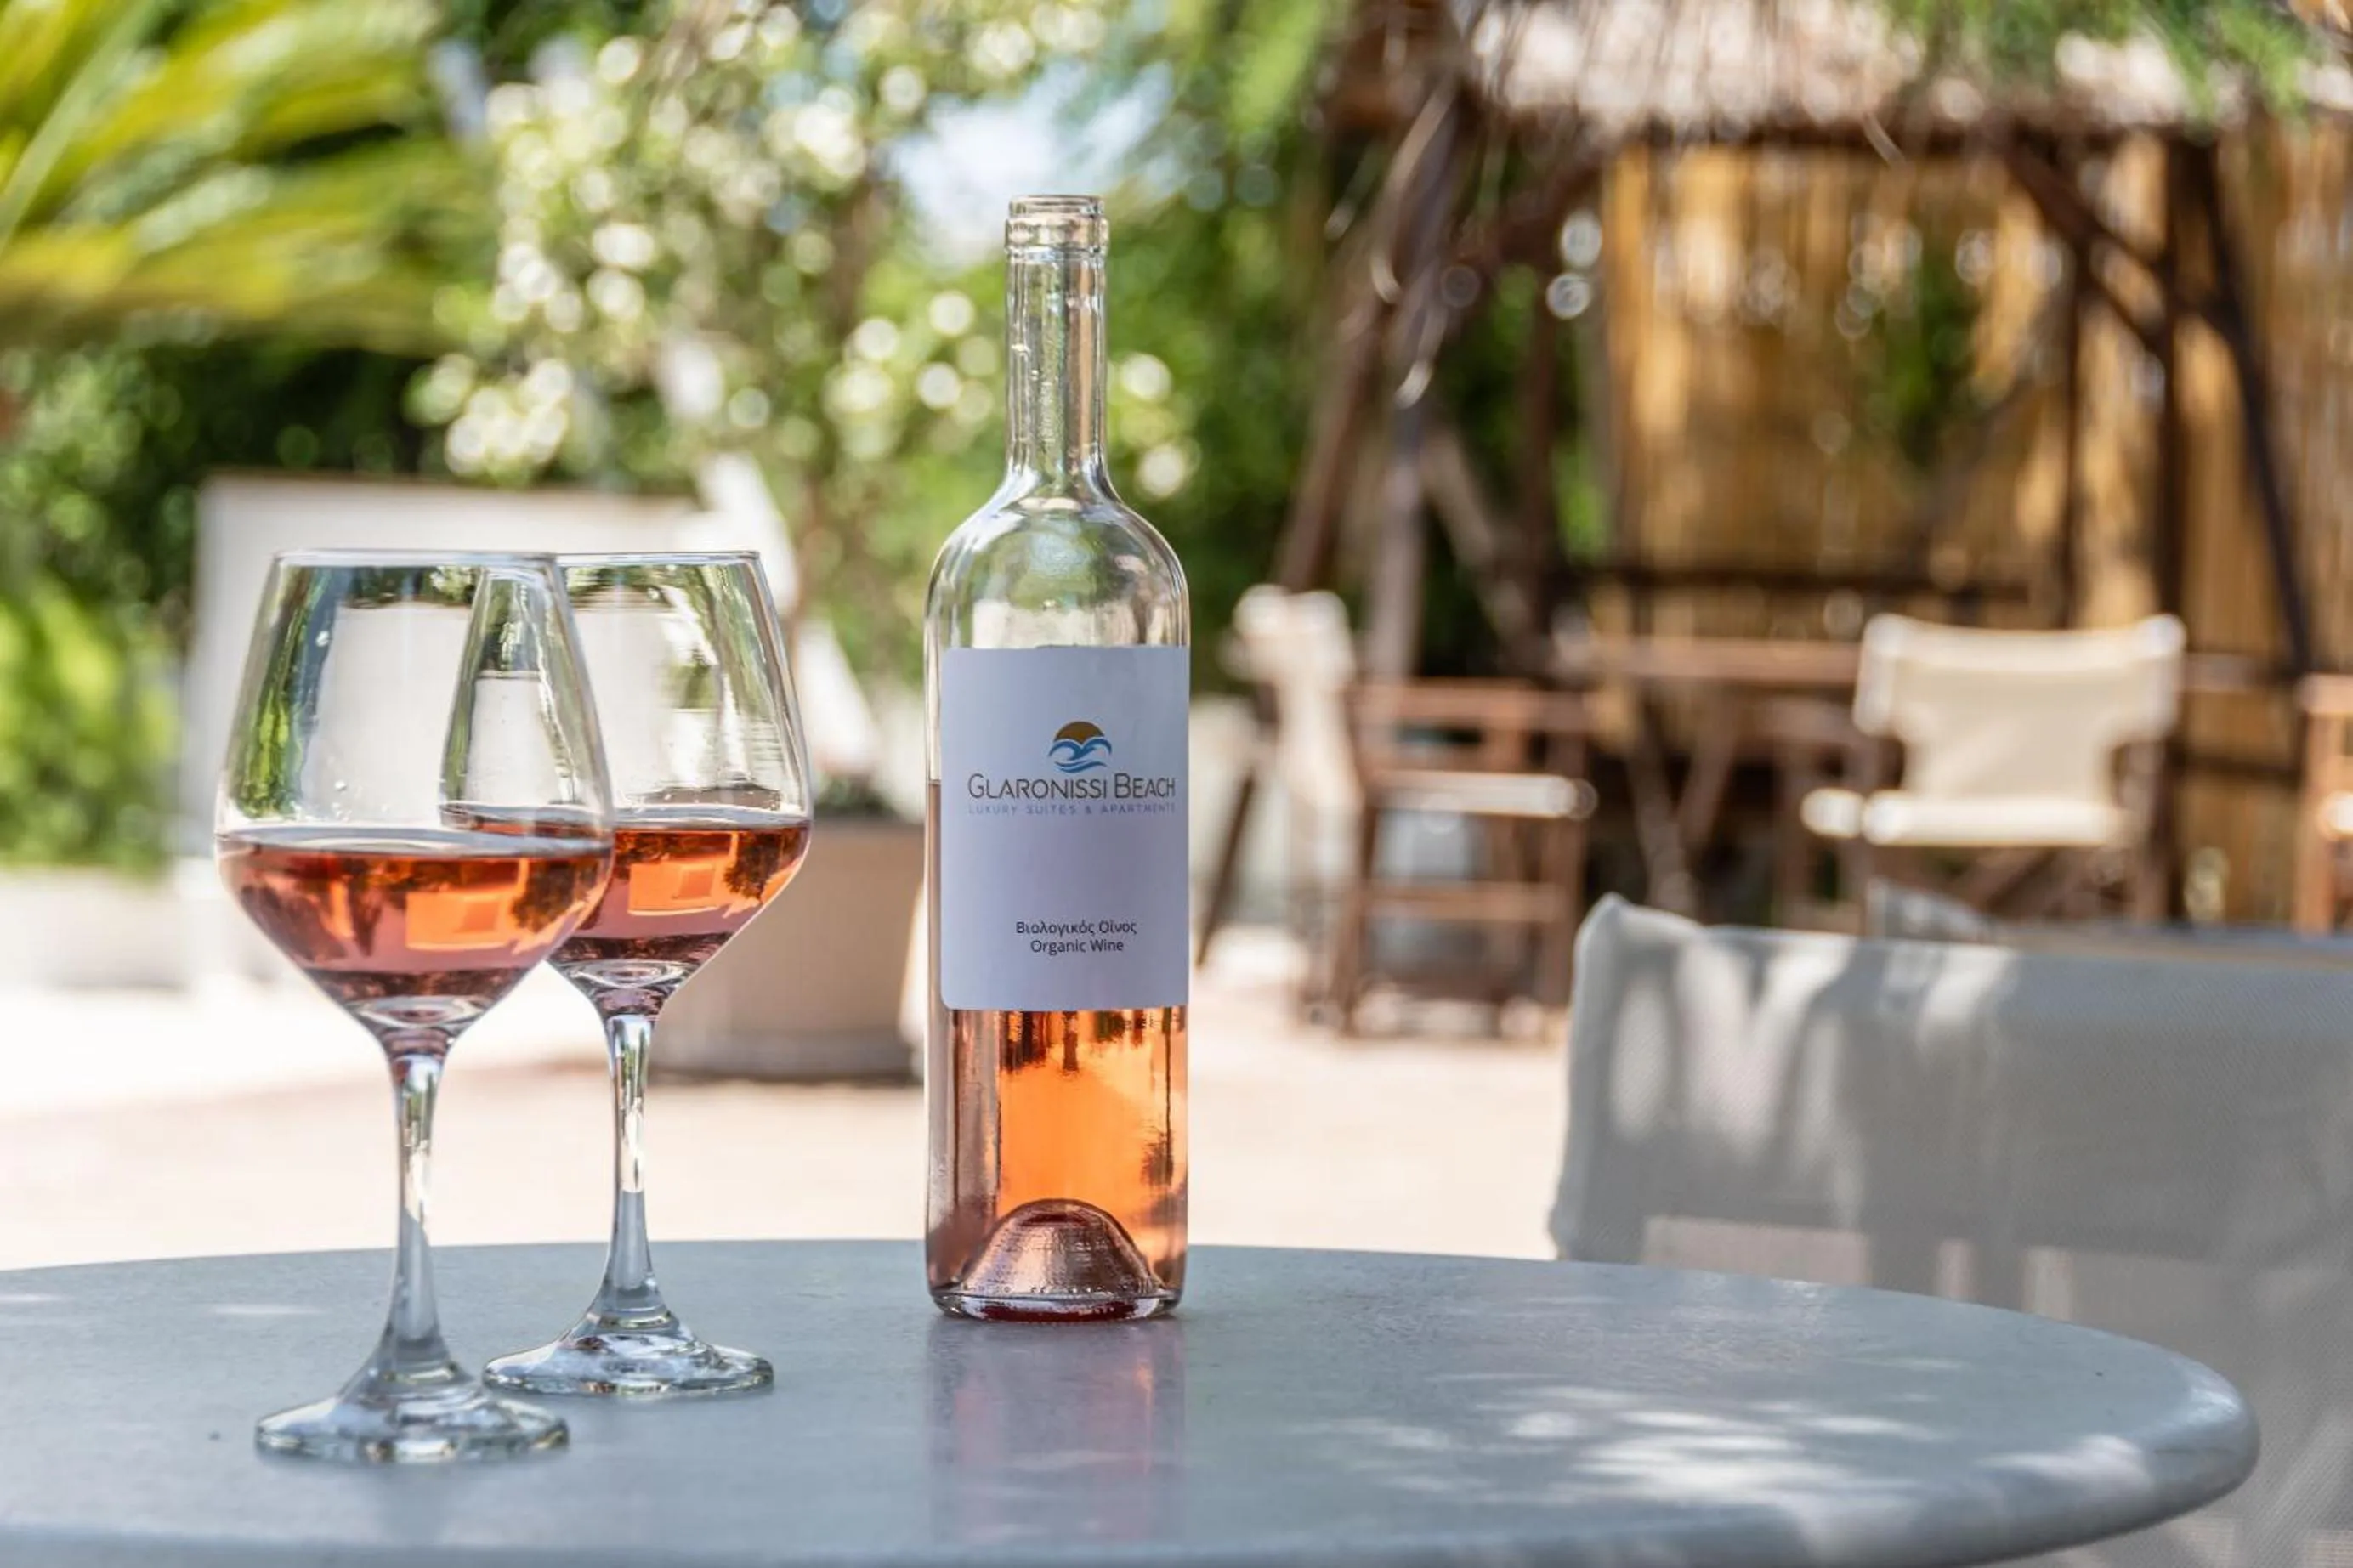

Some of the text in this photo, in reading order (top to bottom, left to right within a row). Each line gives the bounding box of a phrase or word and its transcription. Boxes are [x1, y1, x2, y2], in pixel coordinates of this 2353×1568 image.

[967, 773, 1176, 799] GLARONISSI BEACH
[968, 803, 1017, 815] LUXURY
[1026, 803, 1076, 815] SUITES
[1016, 920, 1095, 937] Βιολογικός
[1029, 939, 1124, 956] Organic Wine
